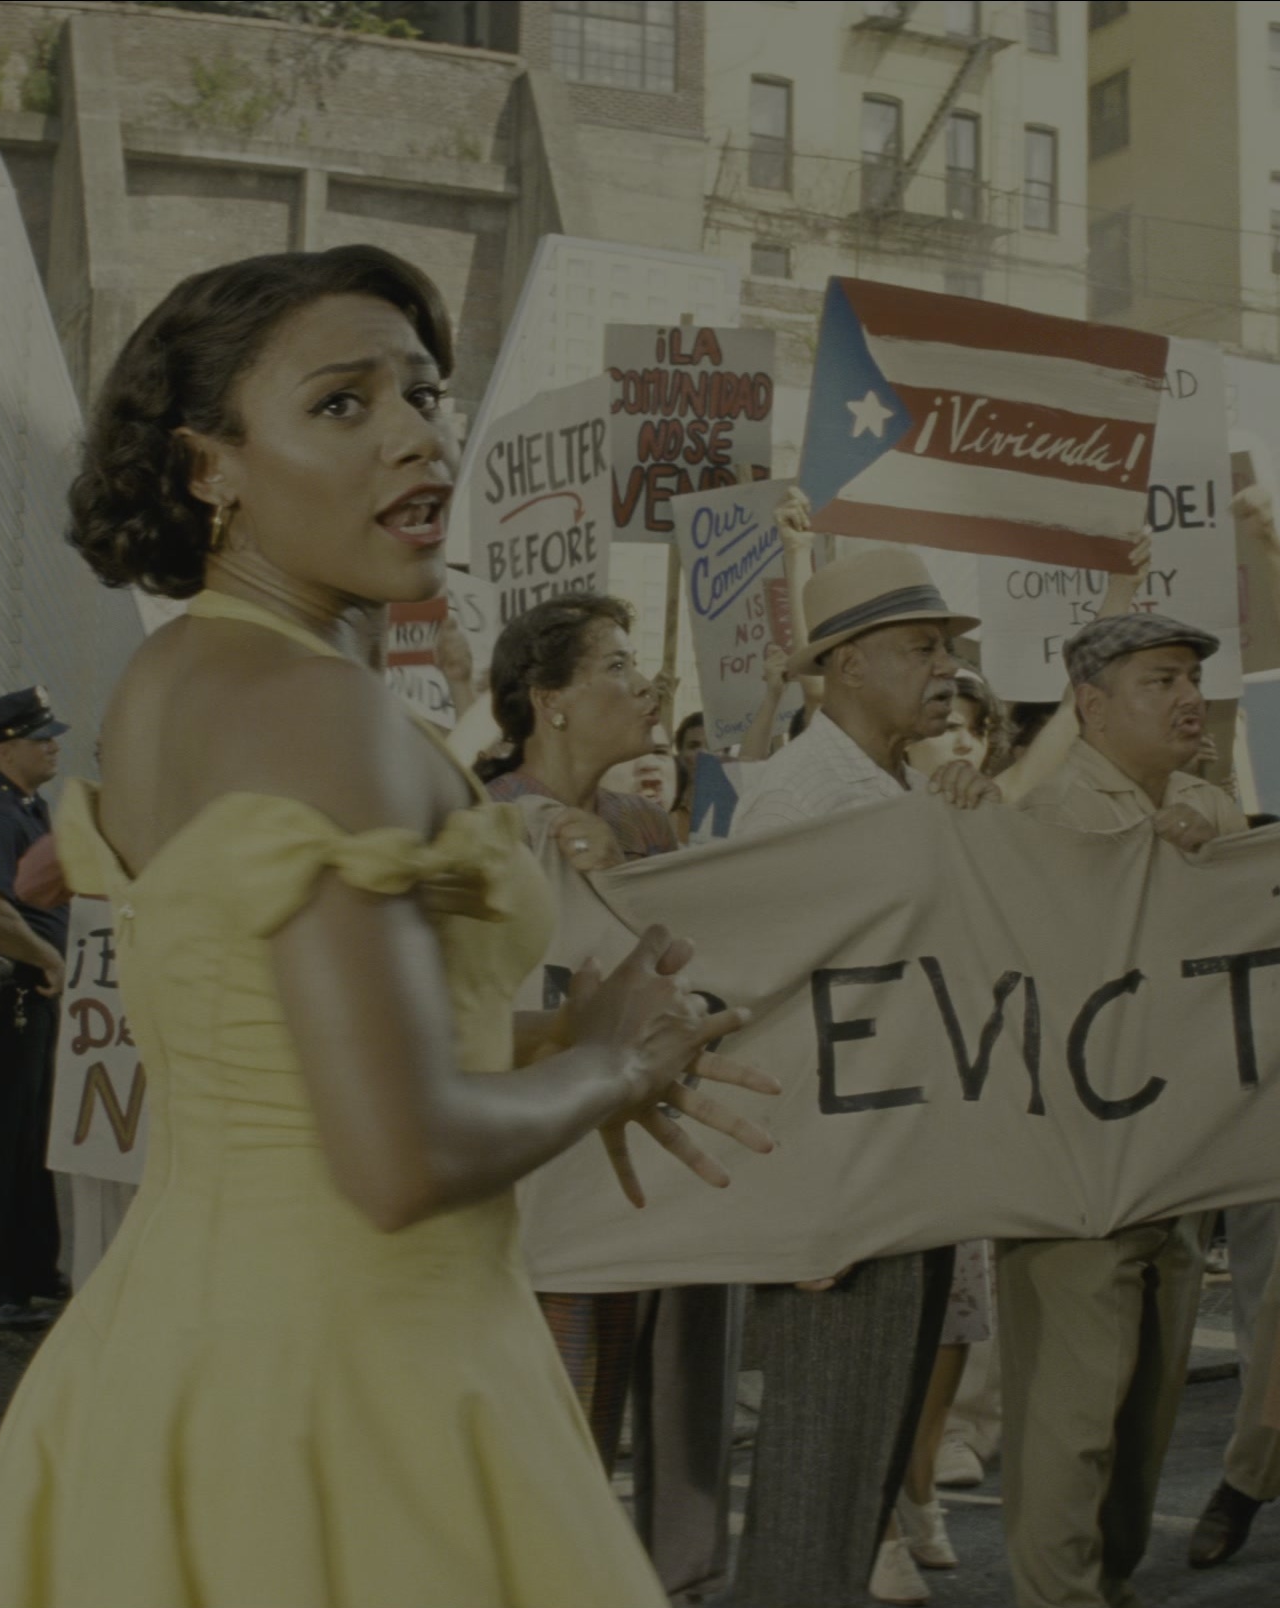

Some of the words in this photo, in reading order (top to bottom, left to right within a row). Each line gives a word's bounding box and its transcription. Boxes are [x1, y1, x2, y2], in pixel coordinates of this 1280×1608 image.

[484, 417, 607, 504] SHELTER
[914, 395, 1147, 484] ¡Vivienda!
[691, 502, 753, 550] Our
[1147, 480, 1217, 533] DE!
[487, 520, 598, 583] BEFORE
[1006, 568, 1178, 601] COMMUTY
[735, 623, 766, 647] NO
